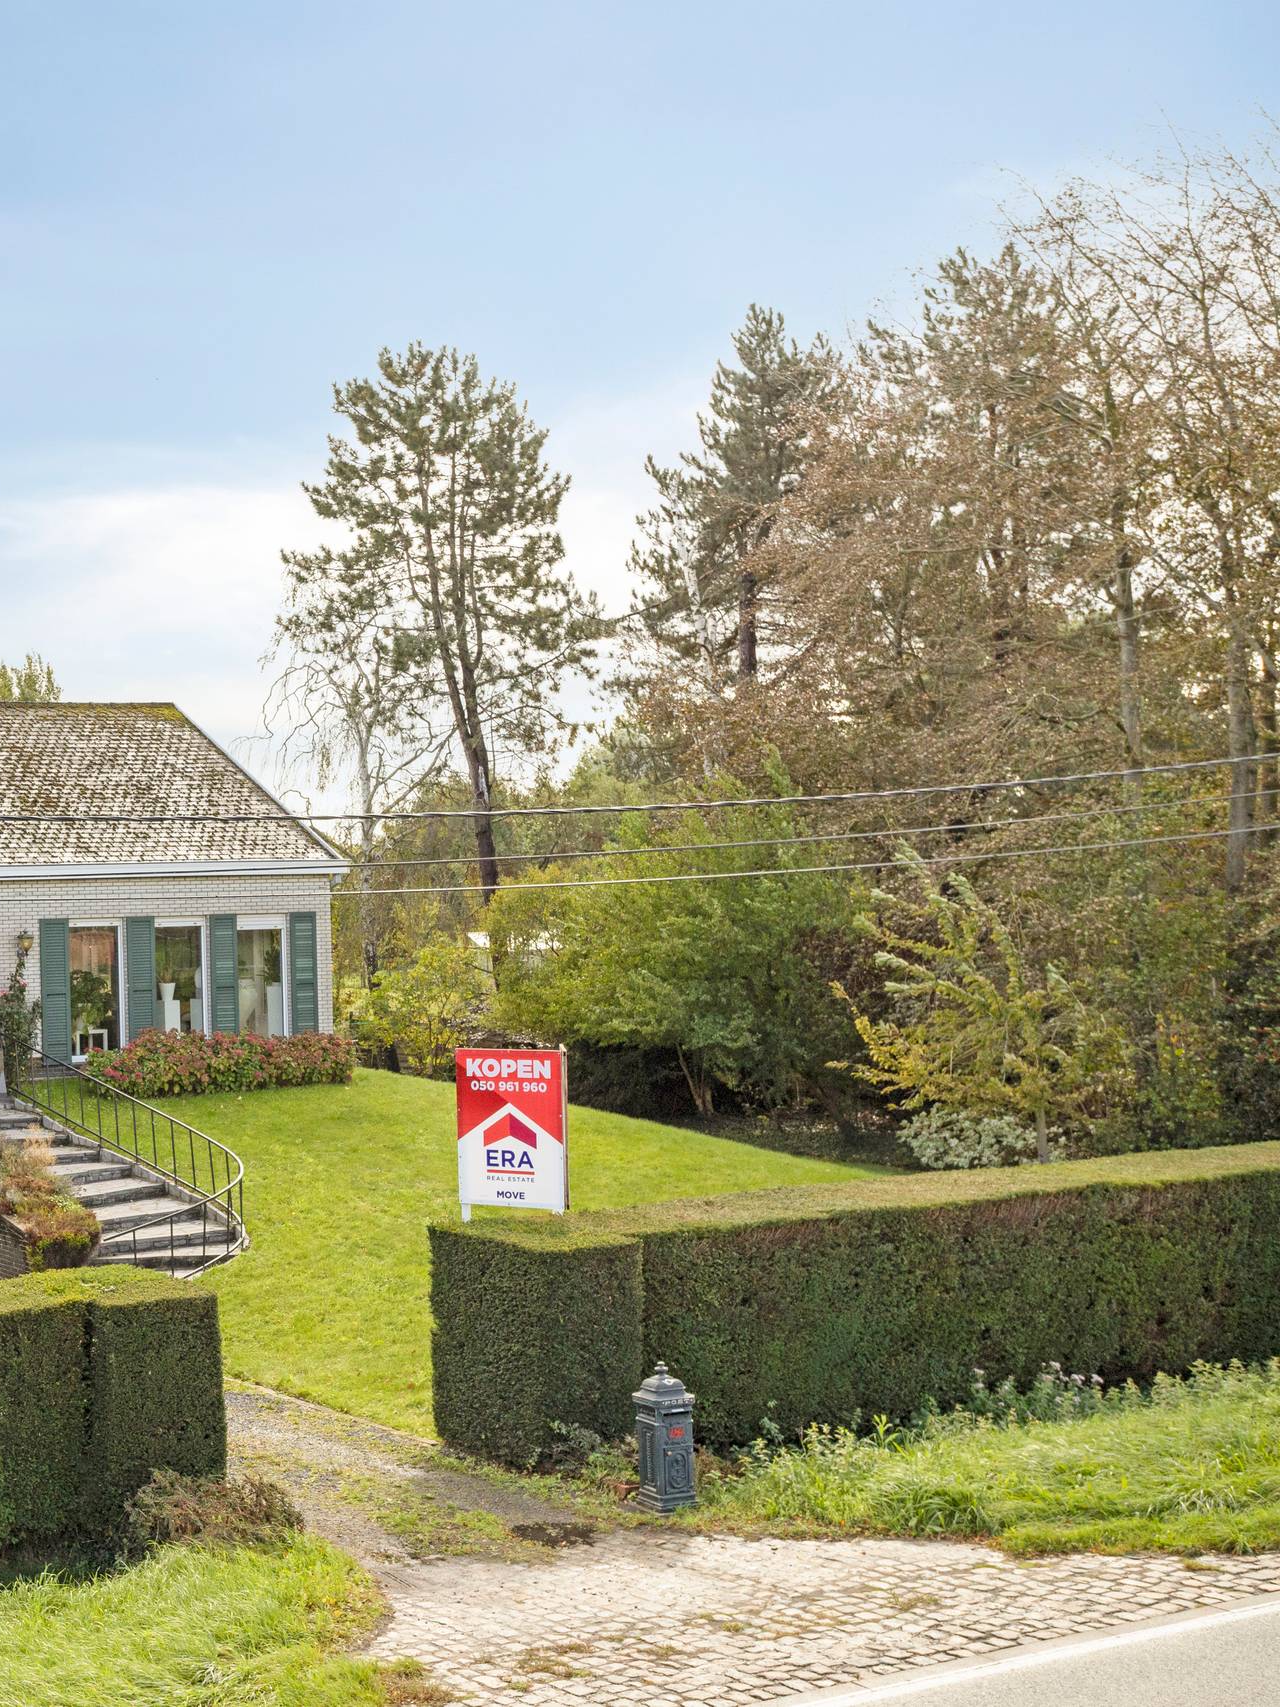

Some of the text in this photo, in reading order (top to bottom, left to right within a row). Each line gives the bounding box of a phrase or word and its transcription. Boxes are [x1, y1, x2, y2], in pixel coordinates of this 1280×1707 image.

[466, 1058, 552, 1080] KOPEN
[470, 1080, 547, 1093] 050 961 960
[486, 1149, 534, 1169] ERA
[496, 1190, 525, 1200] MOVE
